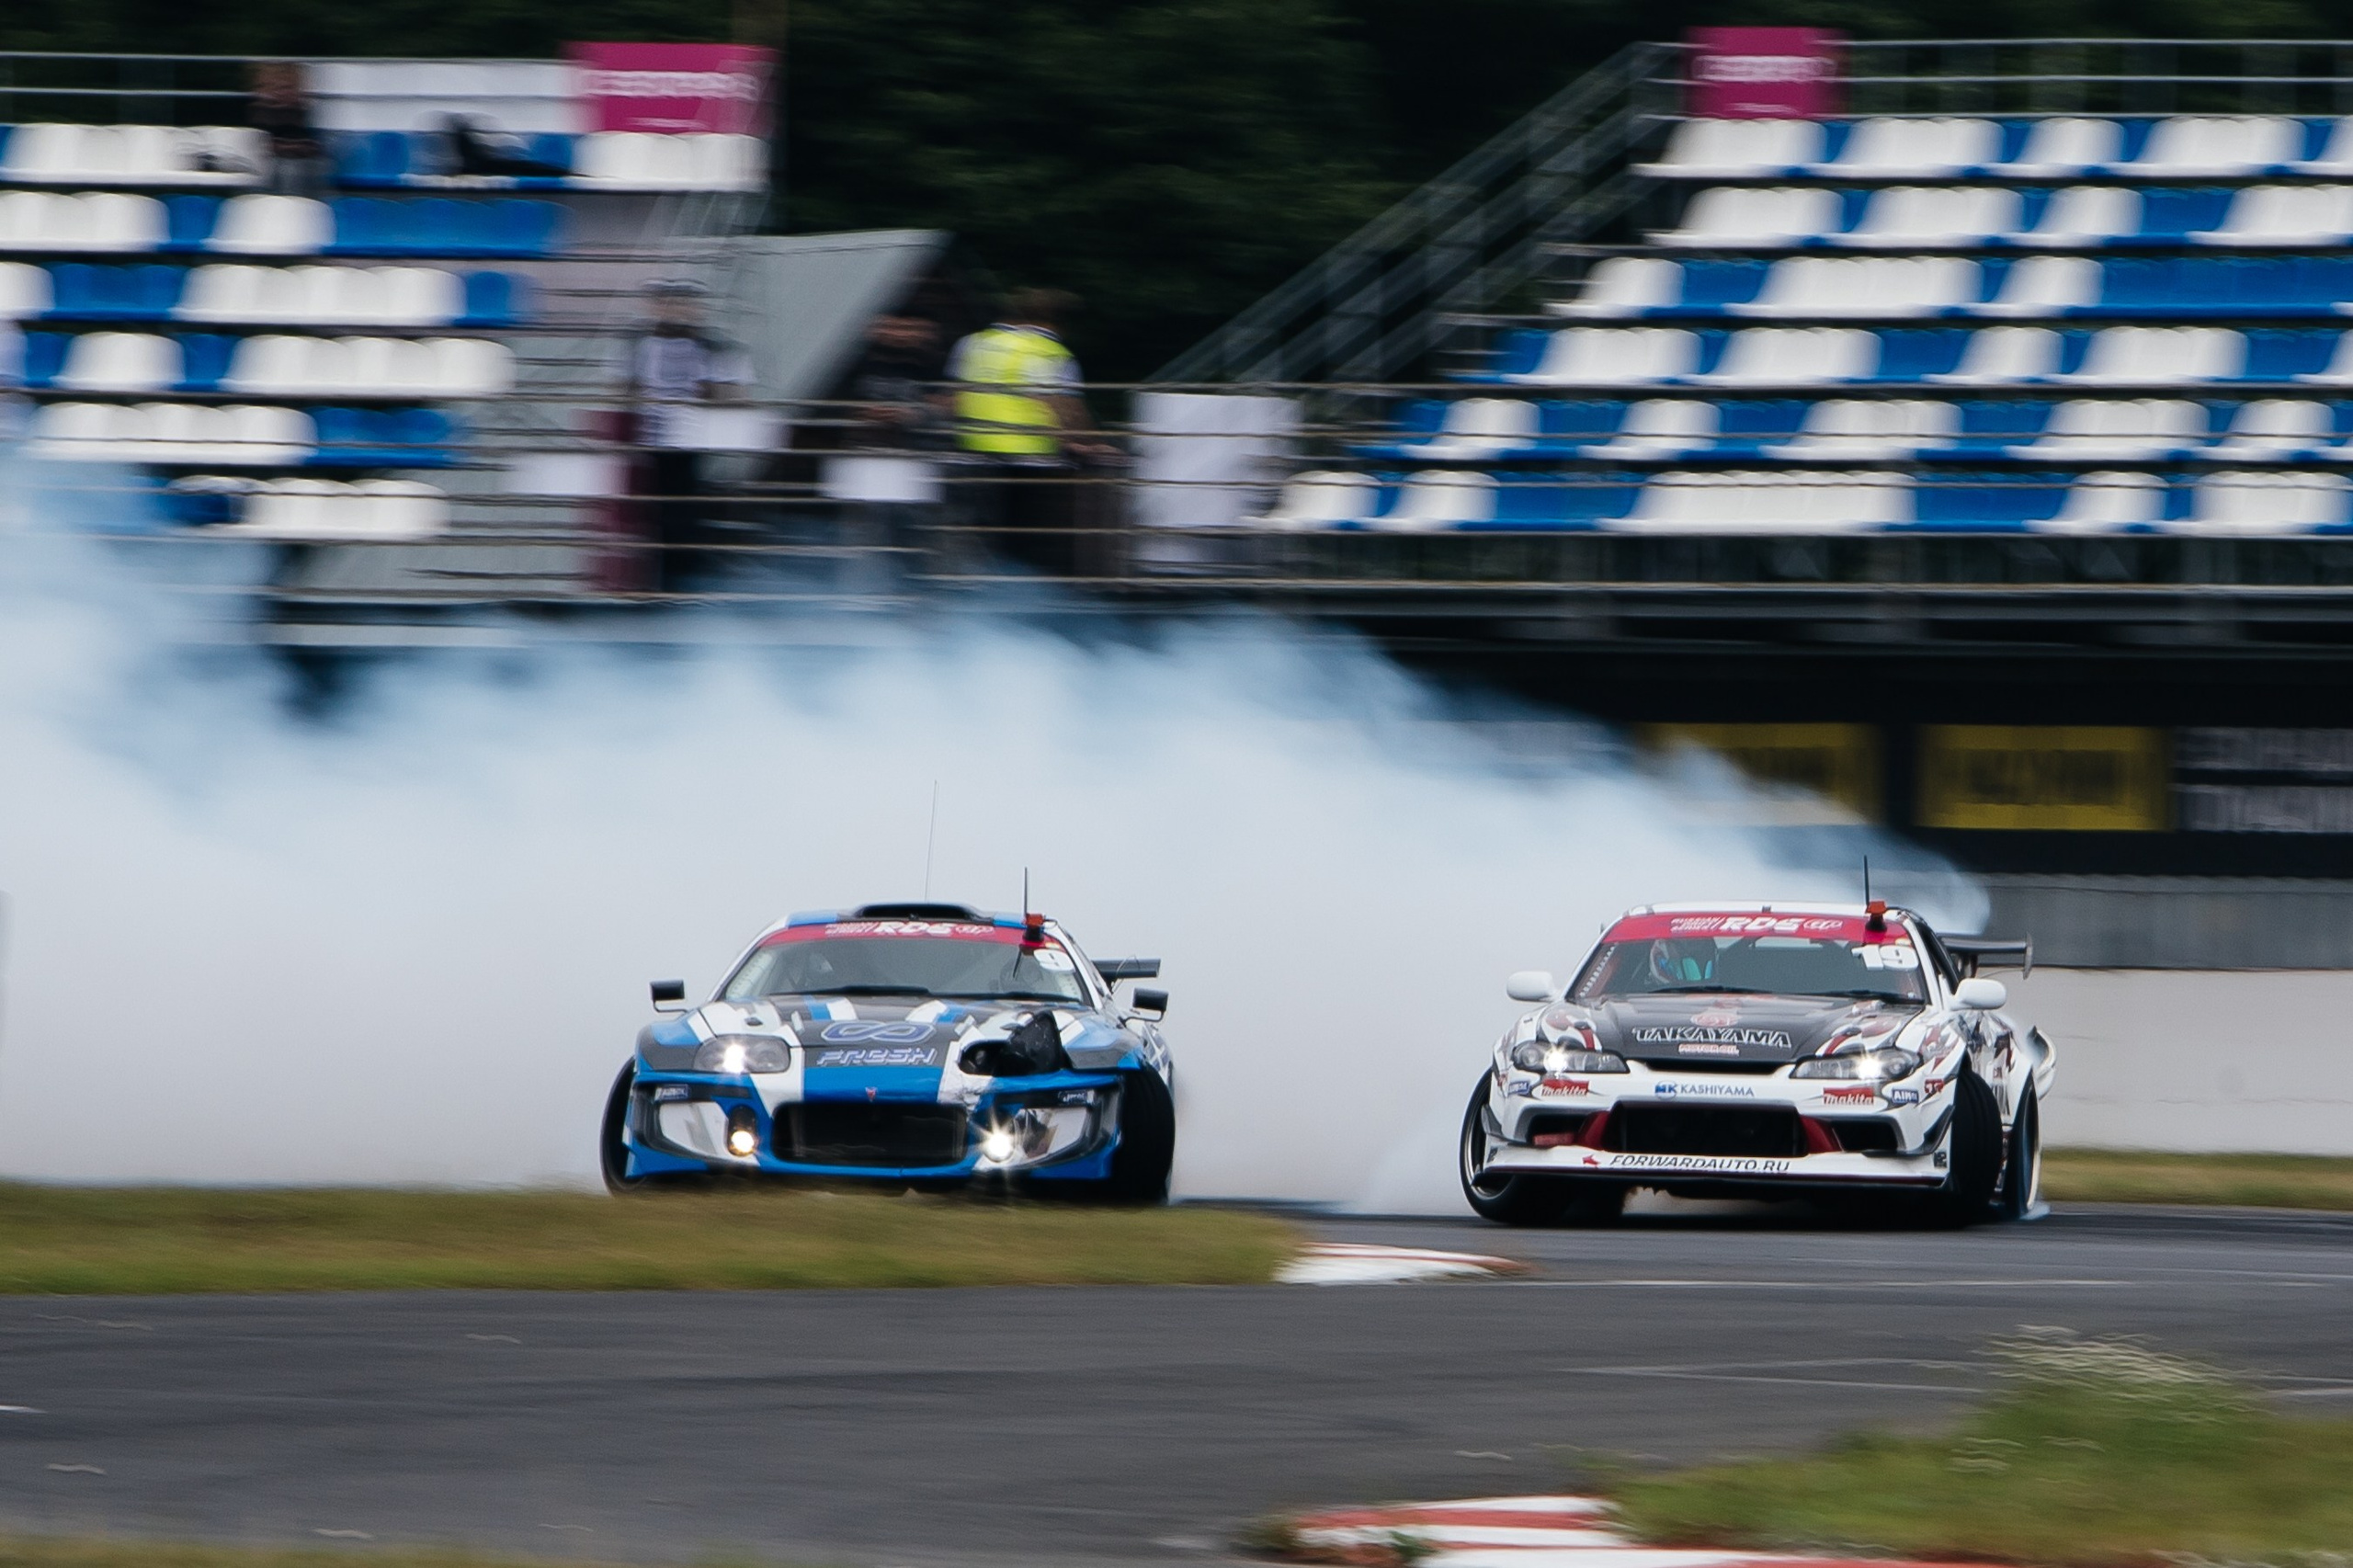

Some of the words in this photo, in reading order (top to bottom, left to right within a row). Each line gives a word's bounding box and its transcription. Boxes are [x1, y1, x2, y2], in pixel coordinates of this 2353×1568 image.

[1719, 916, 1806, 933] RDS
[1033, 949, 1075, 971] 9
[1851, 943, 1921, 971] 19
[1631, 1025, 1792, 1049] TAKAYAMA
[1542, 1085, 1588, 1096] makita
[1680, 1085, 1755, 1096] KASHIYAMA
[1824, 1093, 1874, 1105] makita
[1610, 1153, 1791, 1172] FORWARDAUTO.RU
